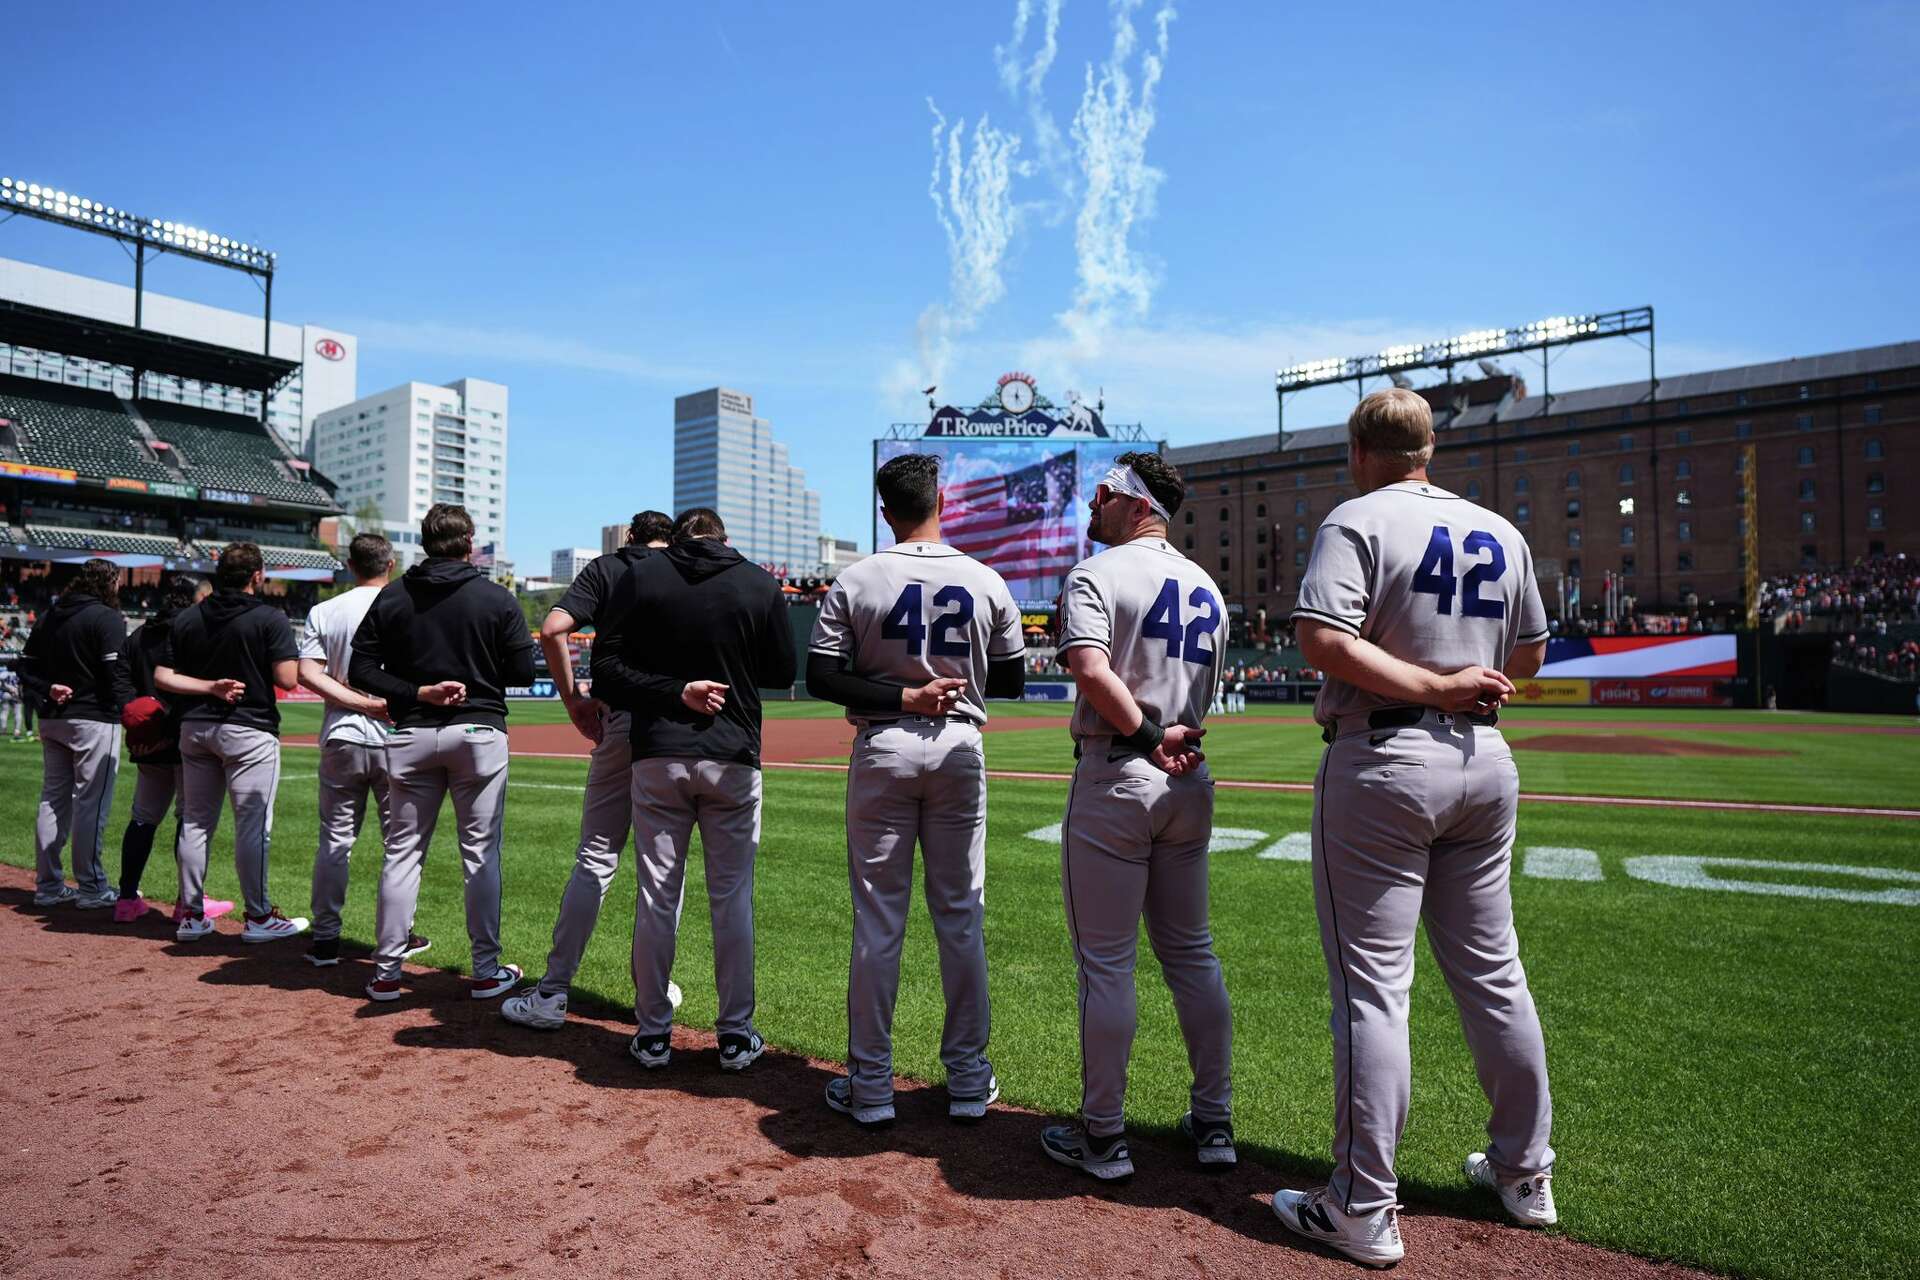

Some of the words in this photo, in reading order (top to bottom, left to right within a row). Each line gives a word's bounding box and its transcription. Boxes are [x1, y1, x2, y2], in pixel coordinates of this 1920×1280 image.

[1412, 526, 1507, 619] 42
[881, 584, 974, 657] 42
[1142, 578, 1220, 666] 42
